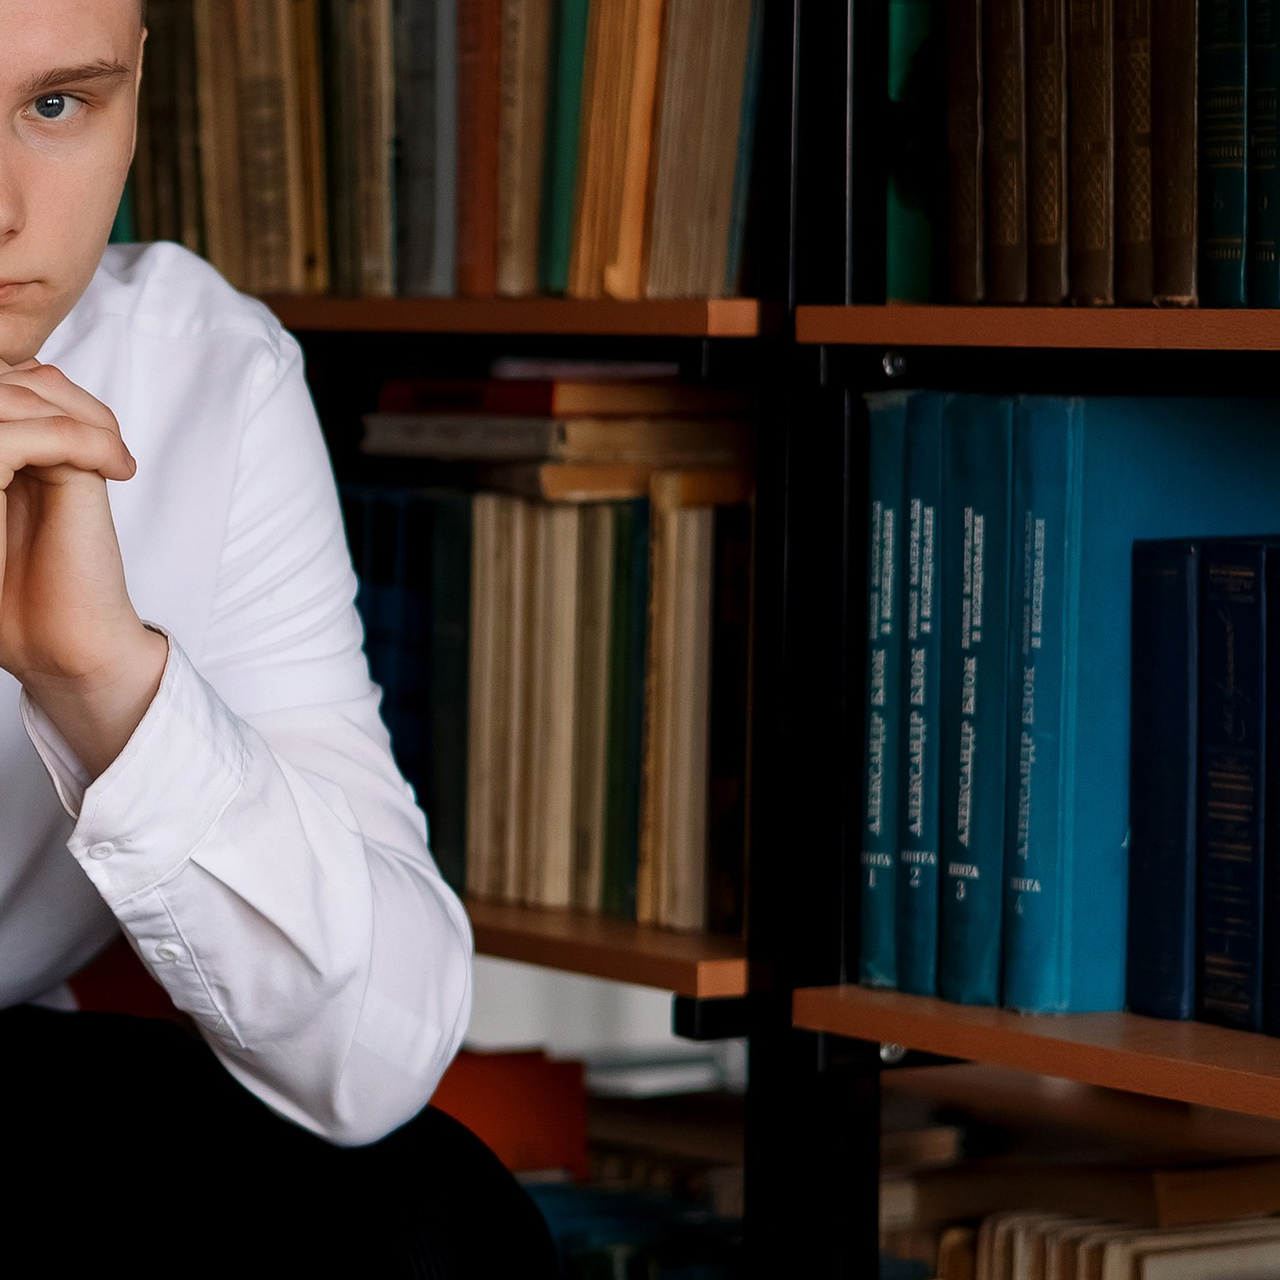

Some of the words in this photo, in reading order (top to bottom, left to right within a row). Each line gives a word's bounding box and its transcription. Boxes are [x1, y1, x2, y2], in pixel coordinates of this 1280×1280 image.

[871, 648, 886, 706] БЛОК
[910, 647, 926, 706] БЛОК
[961, 656, 976, 715] БЛОК
[1021, 666, 1035, 725] БЛОК
[868, 710, 886, 837] АЛЕКСАНДР
[908, 710, 927, 837] АЛЕКСАНДР
[957, 719, 976, 848] АЛЕКСАНДР
[1017, 731, 1036, 860] АЛЕКСАНДР
[868, 867, 877, 889] 1
[908, 865, 921, 888] 2
[955, 879, 966, 902] 3
